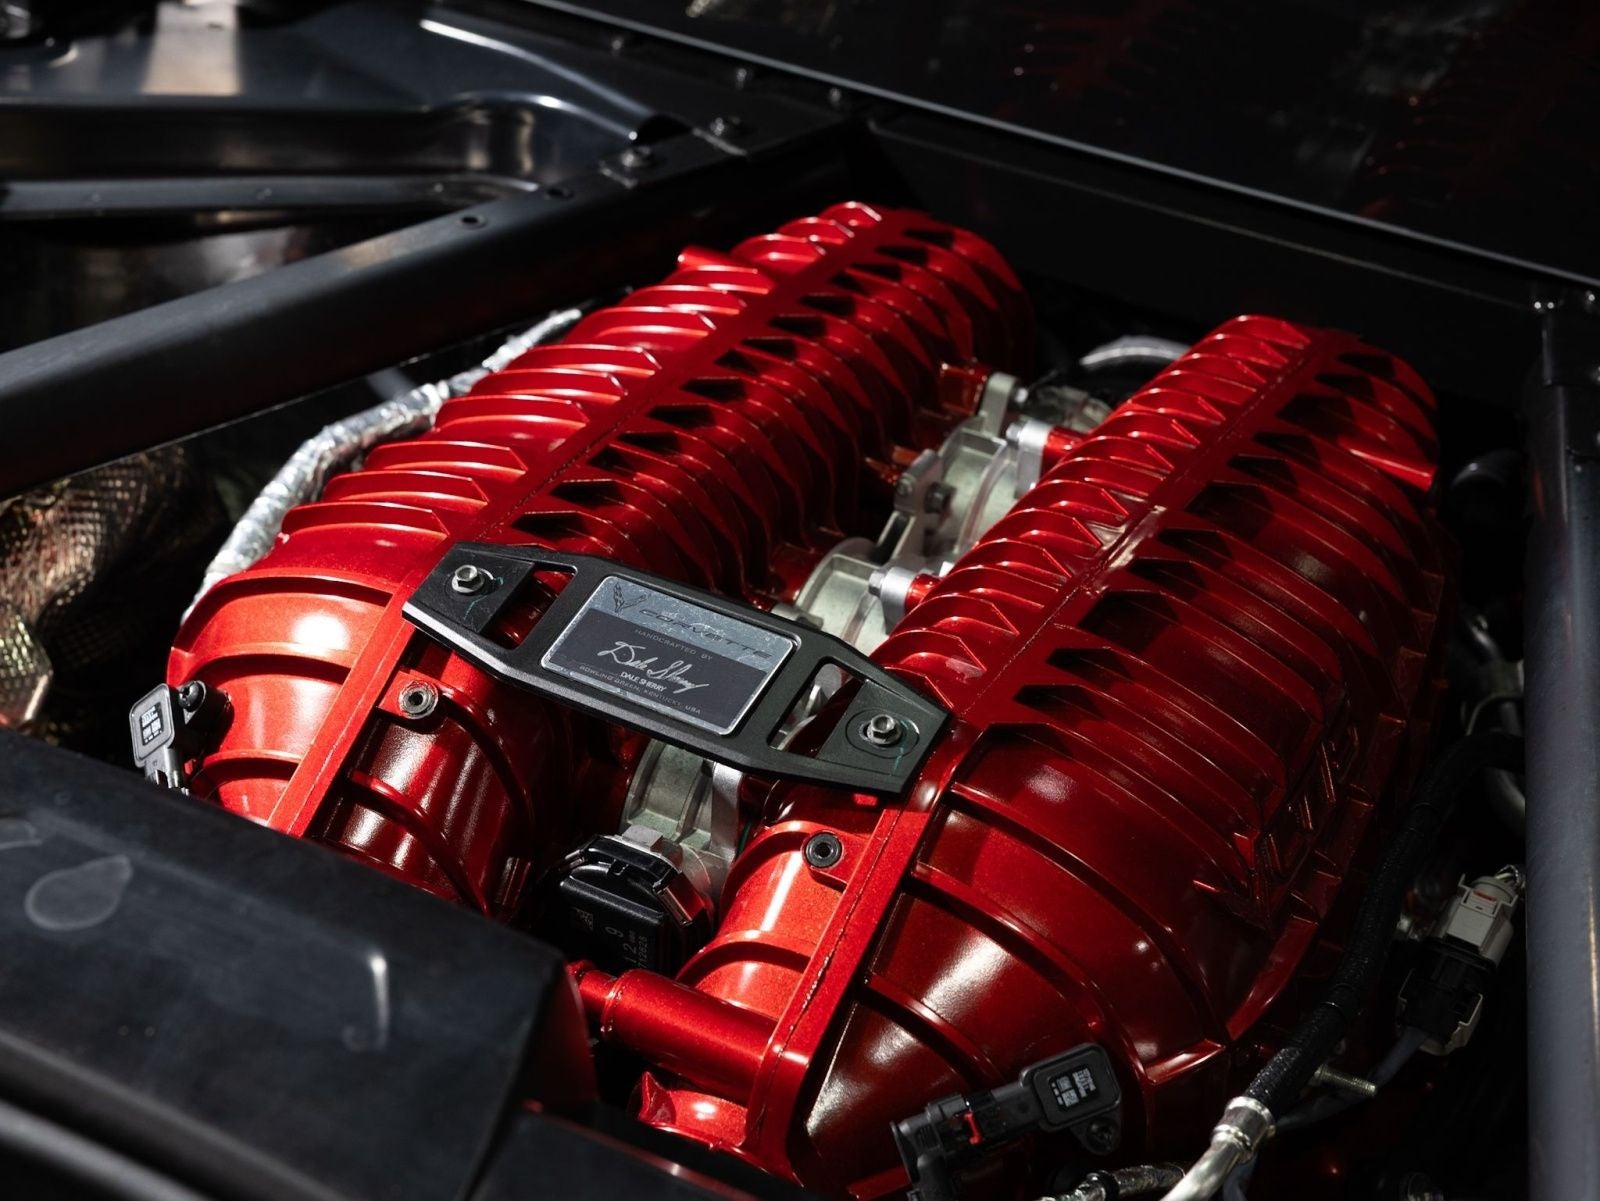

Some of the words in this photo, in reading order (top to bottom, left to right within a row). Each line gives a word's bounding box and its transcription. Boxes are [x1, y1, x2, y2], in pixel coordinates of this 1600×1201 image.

[634, 629, 697, 655] HANDCRAFTED
[700, 653, 713, 661] BY
[639, 608, 772, 659] CORVETTE
[579, 665, 614, 682] BOWLING
[685, 703, 701, 715] USA
[620, 671, 641, 682] DALE
[639, 677, 668, 692] SHERRY
